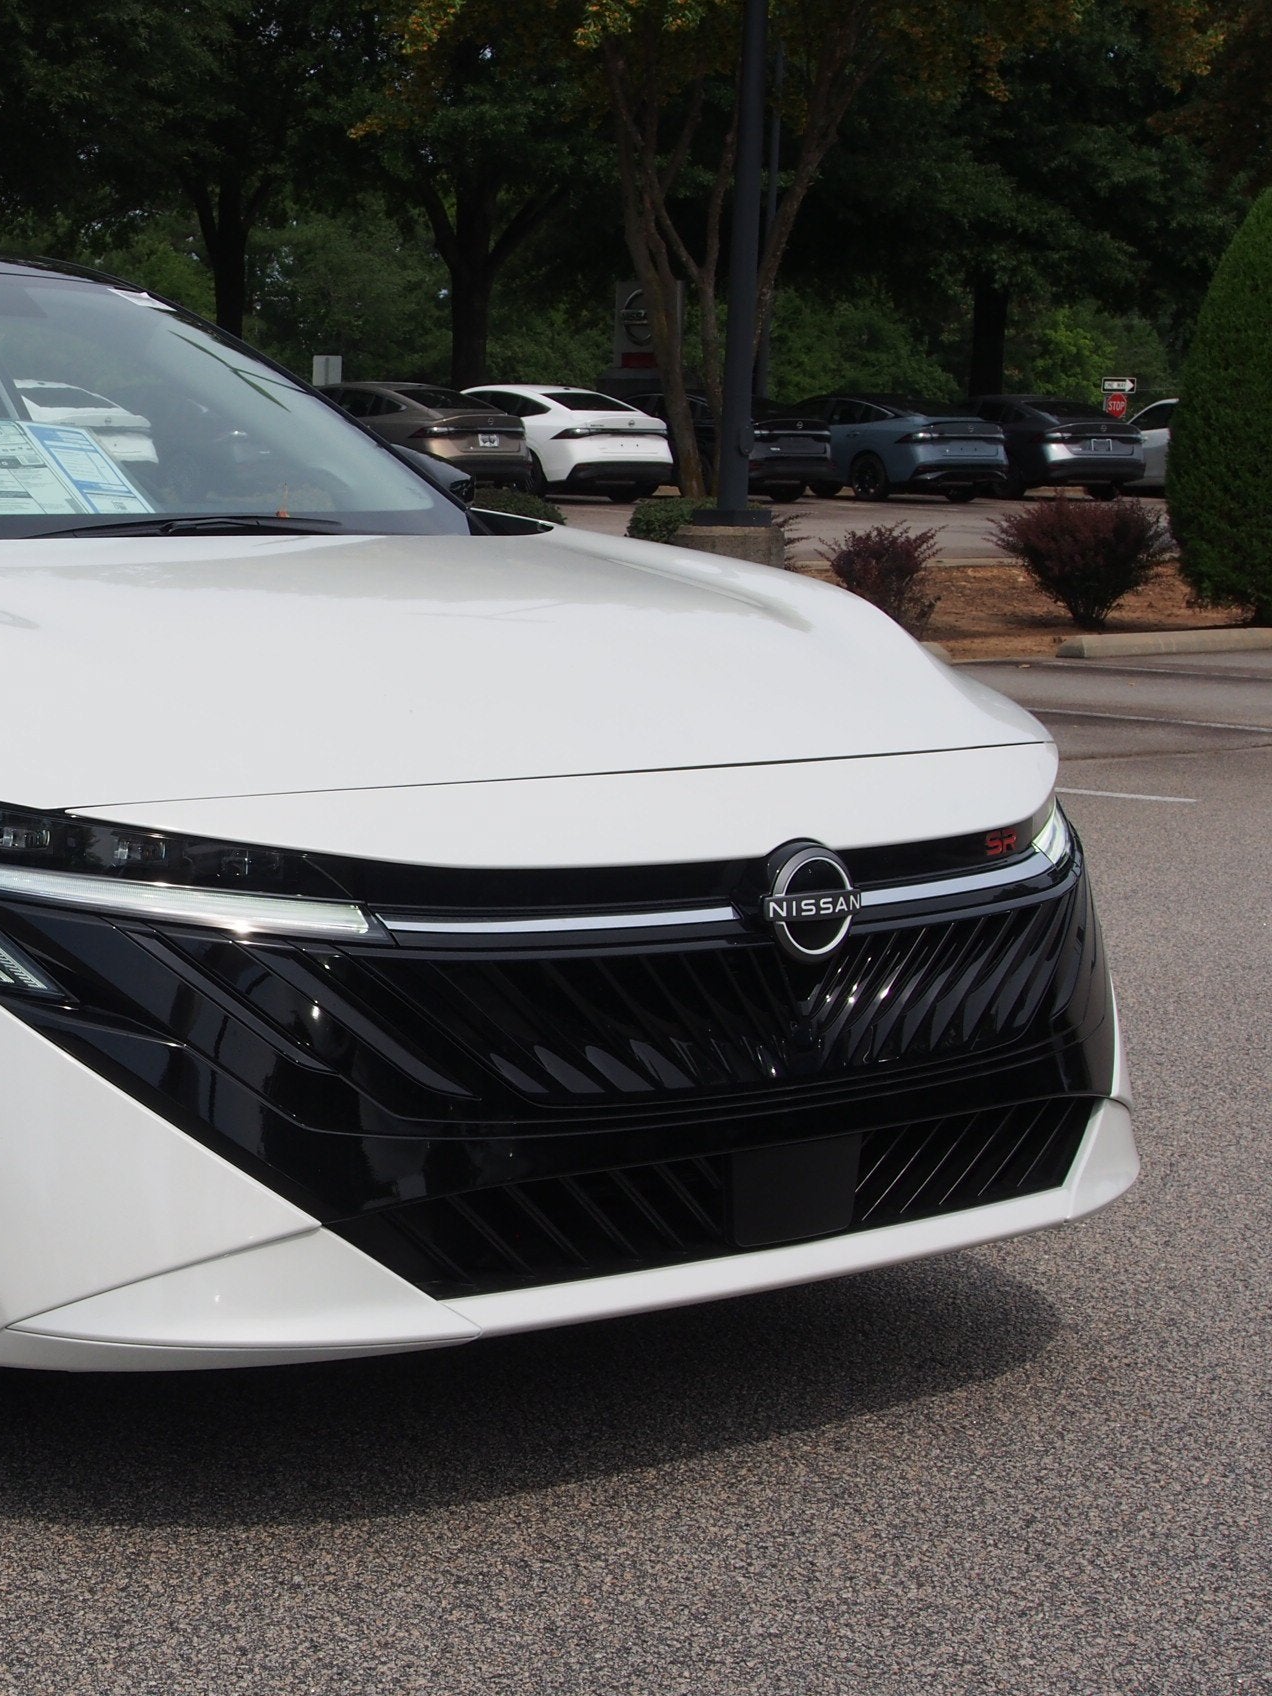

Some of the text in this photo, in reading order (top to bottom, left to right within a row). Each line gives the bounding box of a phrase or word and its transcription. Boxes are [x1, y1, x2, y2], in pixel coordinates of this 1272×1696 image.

[1108, 401, 1125, 411] STOP
[985, 829, 1017, 856] SR
[769, 893, 861, 918] NISSAN
